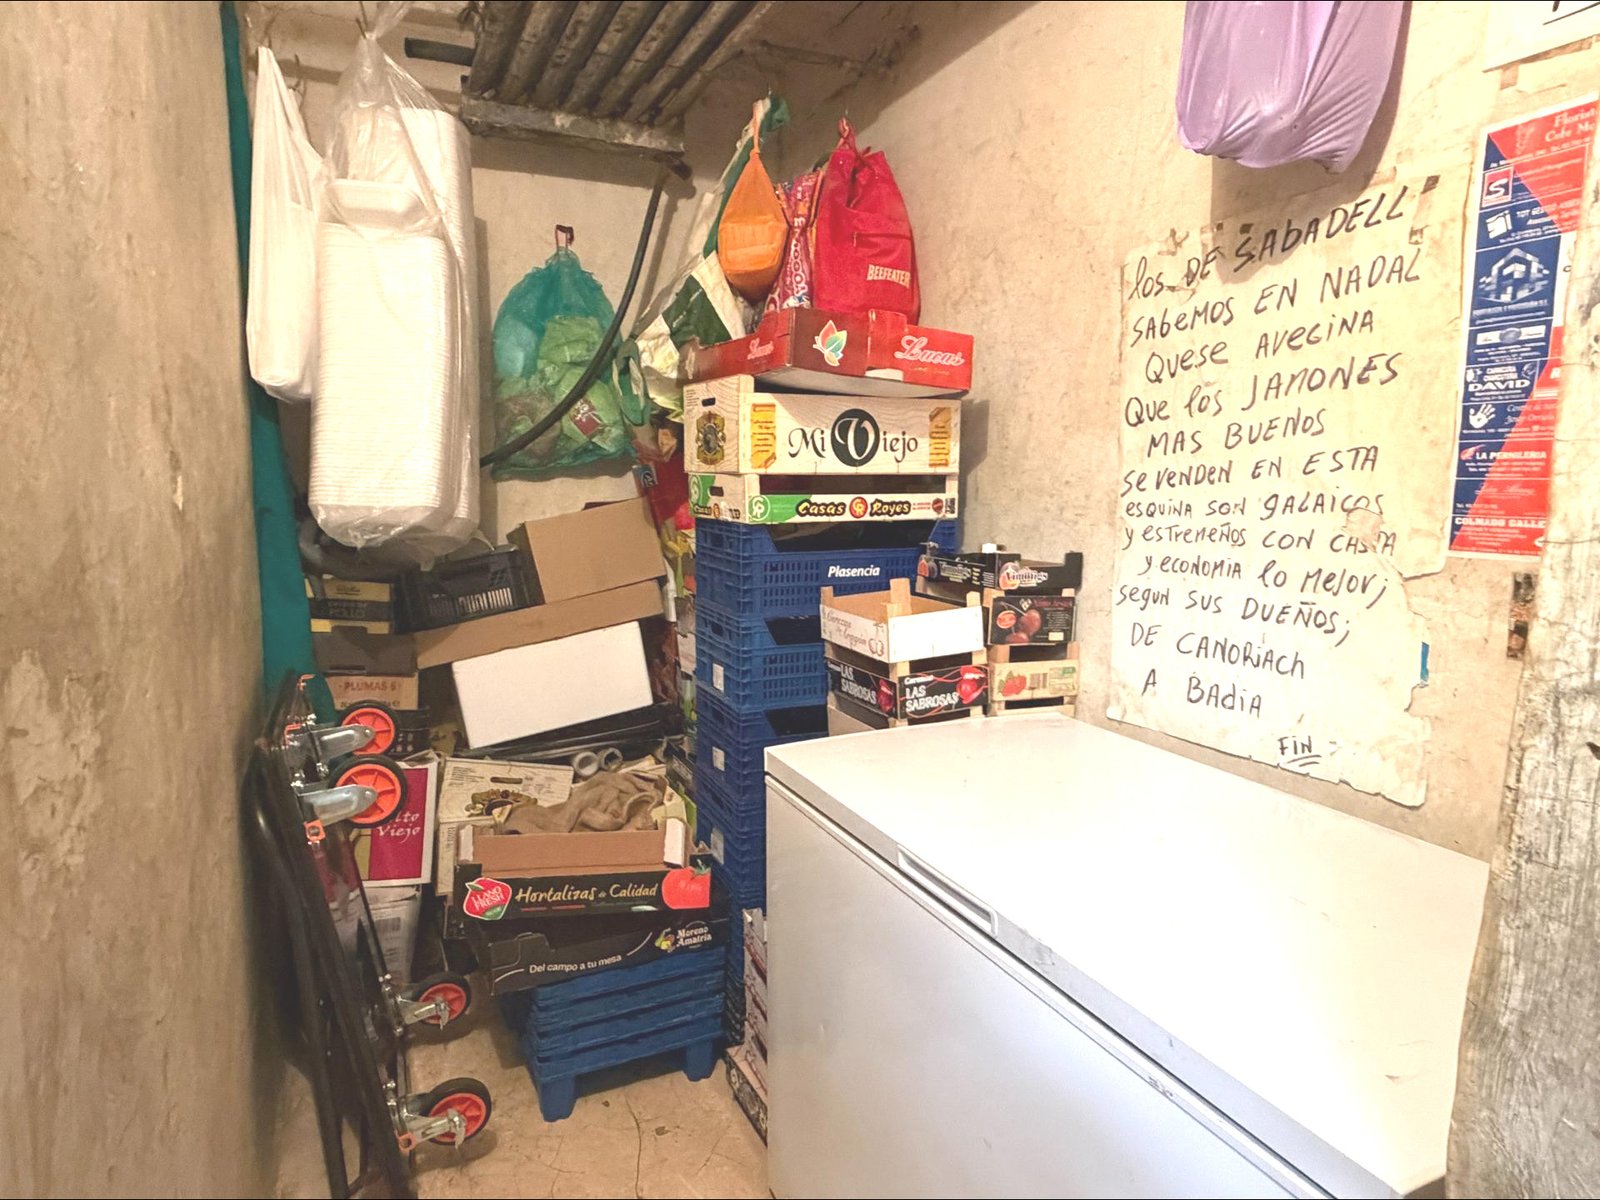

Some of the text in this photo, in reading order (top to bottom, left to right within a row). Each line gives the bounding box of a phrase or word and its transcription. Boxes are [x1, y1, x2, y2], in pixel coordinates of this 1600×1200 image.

[866, 264, 911, 288] BEEFEATER
[1254, 278, 1298, 315] EN
[1320, 248, 1421, 303] NADAL
[894, 335, 965, 367] Lucas
[1468, 379, 1530, 392] DAVID
[788, 427, 826, 458] Mi
[1147, 407, 1326, 458] MAS BUENOS
[1251, 456, 1282, 479] EN
[1302, 445, 1379, 475] ESTA
[1475, 451, 1487, 460] LA
[796, 498, 846, 516] Casas
[1508, 519, 1547, 529] GALLE
[1262, 528, 1315, 550] CON
[827, 564, 880, 578] Plasencia
[1130, 622, 1162, 647] DE
[840, 663, 854, 681] LAS
[1141, 668, 1158, 697] A
[841, 678, 877, 705] SABROSAS
[905, 684, 926, 700] LAS
[905, 691, 960, 712] SABROSAS
[376, 823, 421, 843] Viejo
[515, 884, 597, 902] Hortalizas
[609, 883, 659, 898] Calidad
[529, 964, 545, 975] Del
[547, 963, 578, 974] campo
[587, 960, 597, 968] tu
[599, 955, 622, 966] mesa
